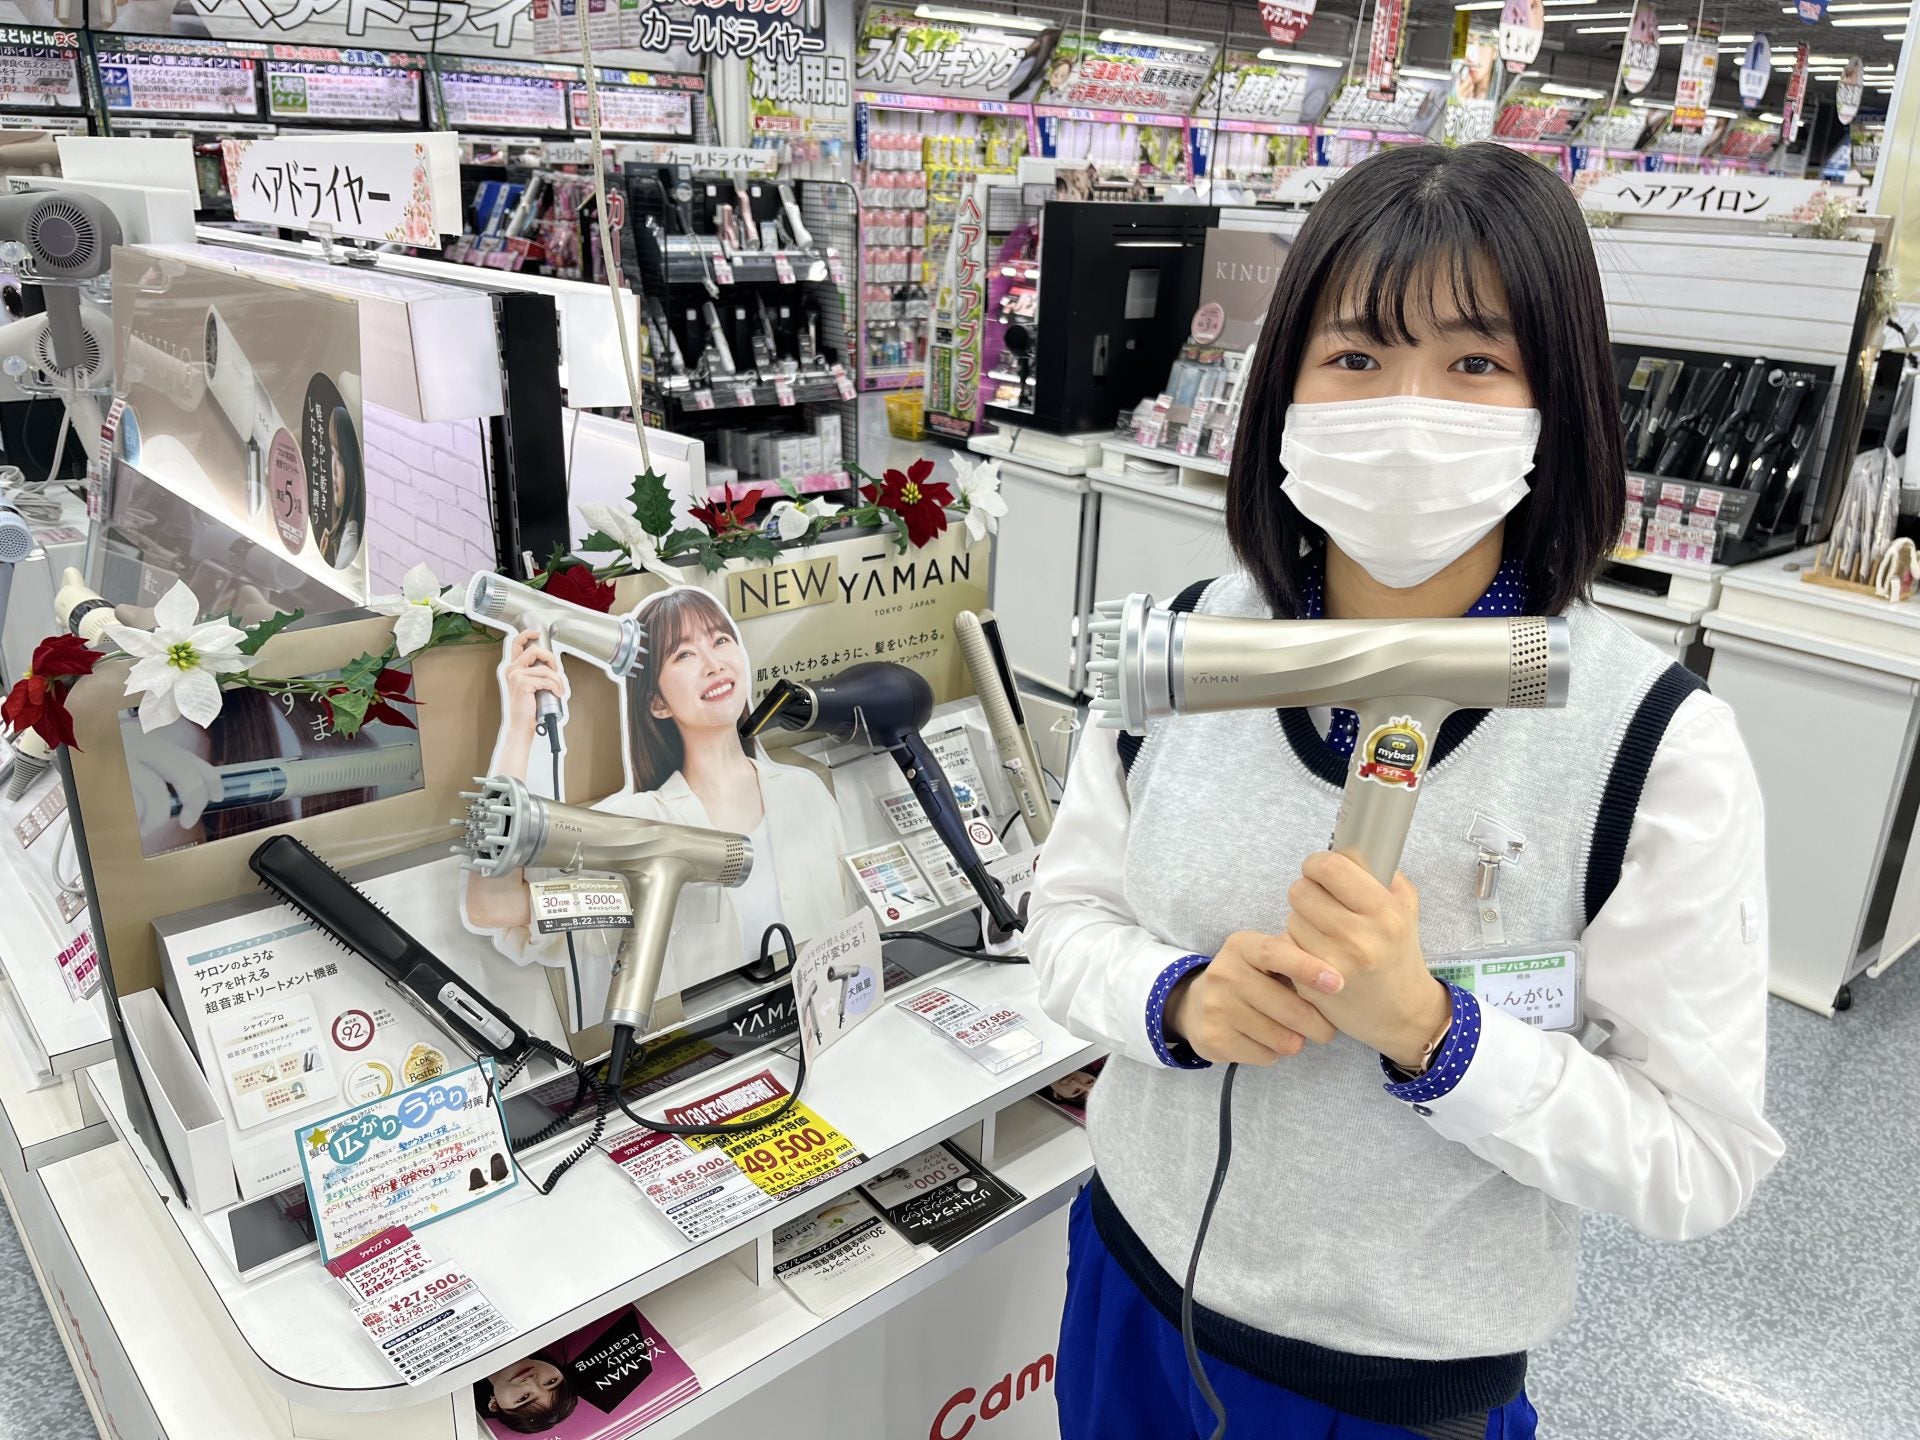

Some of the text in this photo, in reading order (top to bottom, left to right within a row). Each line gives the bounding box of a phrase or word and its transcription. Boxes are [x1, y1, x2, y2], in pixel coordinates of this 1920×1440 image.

[641, 9, 825, 61] カールドライヤー
[751, 52, 848, 107] 洗顔用品
[856, 36, 1026, 91] ストッキング
[666, 150, 768, 169] カールドライヤー
[252, 162, 391, 225] ヘアドライヤー
[1617, 183, 1770, 215] ヘアアイロン
[740, 562, 831, 613] NEW
[874, 598, 936, 617] TOKYO JAPAN
[757, 629, 946, 683] 肌をいたわるように、髪をいたわる。
[1377, 748, 1415, 761] mybest
[1376, 766, 1408, 777] ドライヤー
[195, 949, 275, 981] サロンのような
[1485, 957, 1561, 973] ヨドバシカメラ
[199, 967, 271, 998] ケアを叶える
[204, 962, 339, 1015] 超音波トリートメント機器
[847, 976, 873, 1000] 大風量
[1485, 986, 1564, 1007] しんがい
[243, 1014, 285, 1032] シャインプロ
[409, 1063, 443, 1084] Bestbuy
[414, 1055, 431, 1068] LDK
[462, 1095, 484, 1111] 対策
[626, 1144, 680, 1173] こちらのカードを
[632, 1150, 683, 1178] カウンターまで
[909, 1187, 991, 1231] リフトドライヤー
[353, 1243, 422, 1283] こちらのカードを
[359, 1251, 422, 1291] カウンターまで
[814, 1244, 872, 1278] リフトドライヤー
[365, 1258, 433, 1297] お持ちください。
[353, 1296, 383, 1313] ヤーマン
[575, 1333, 640, 1372] Learning
[595, 1346, 667, 1391] YA-MAN
[607, 1337, 656, 1369] Beauty
